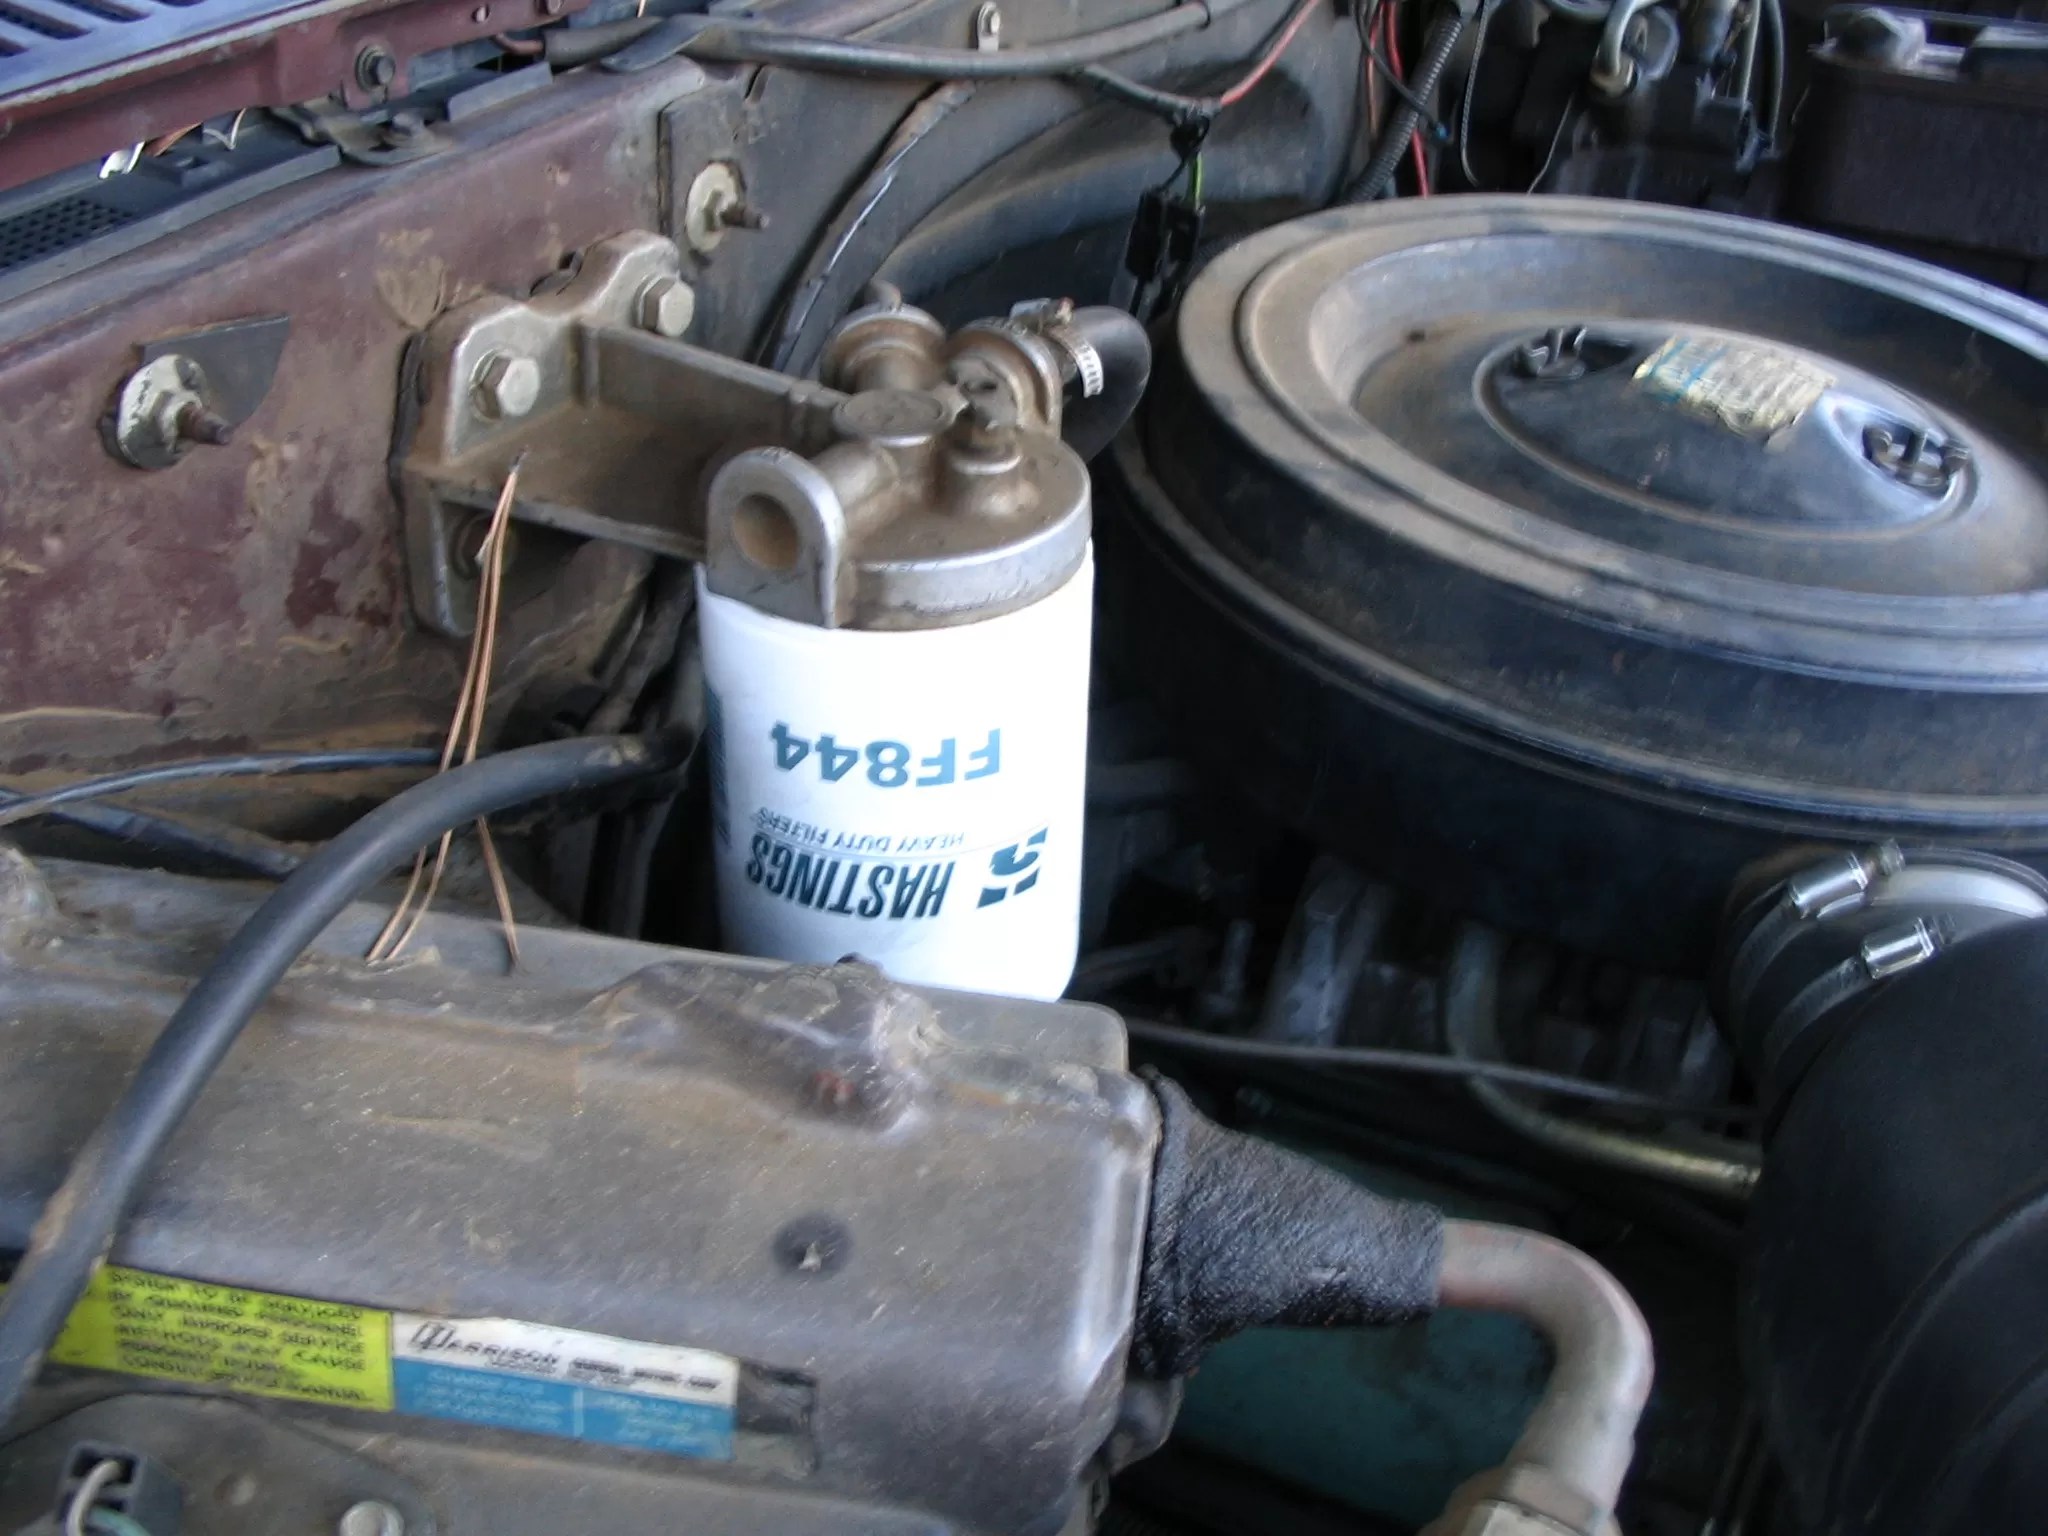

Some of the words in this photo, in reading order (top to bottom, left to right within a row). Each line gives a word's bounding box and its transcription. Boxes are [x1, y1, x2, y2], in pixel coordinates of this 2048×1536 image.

[769, 718, 1001, 788] FF844
[752, 806, 831, 845] FILTERS
[830, 832, 889, 853] DUTY
[896, 831, 964, 854] HEAVY
[744, 831, 956, 922] HASTINGS
